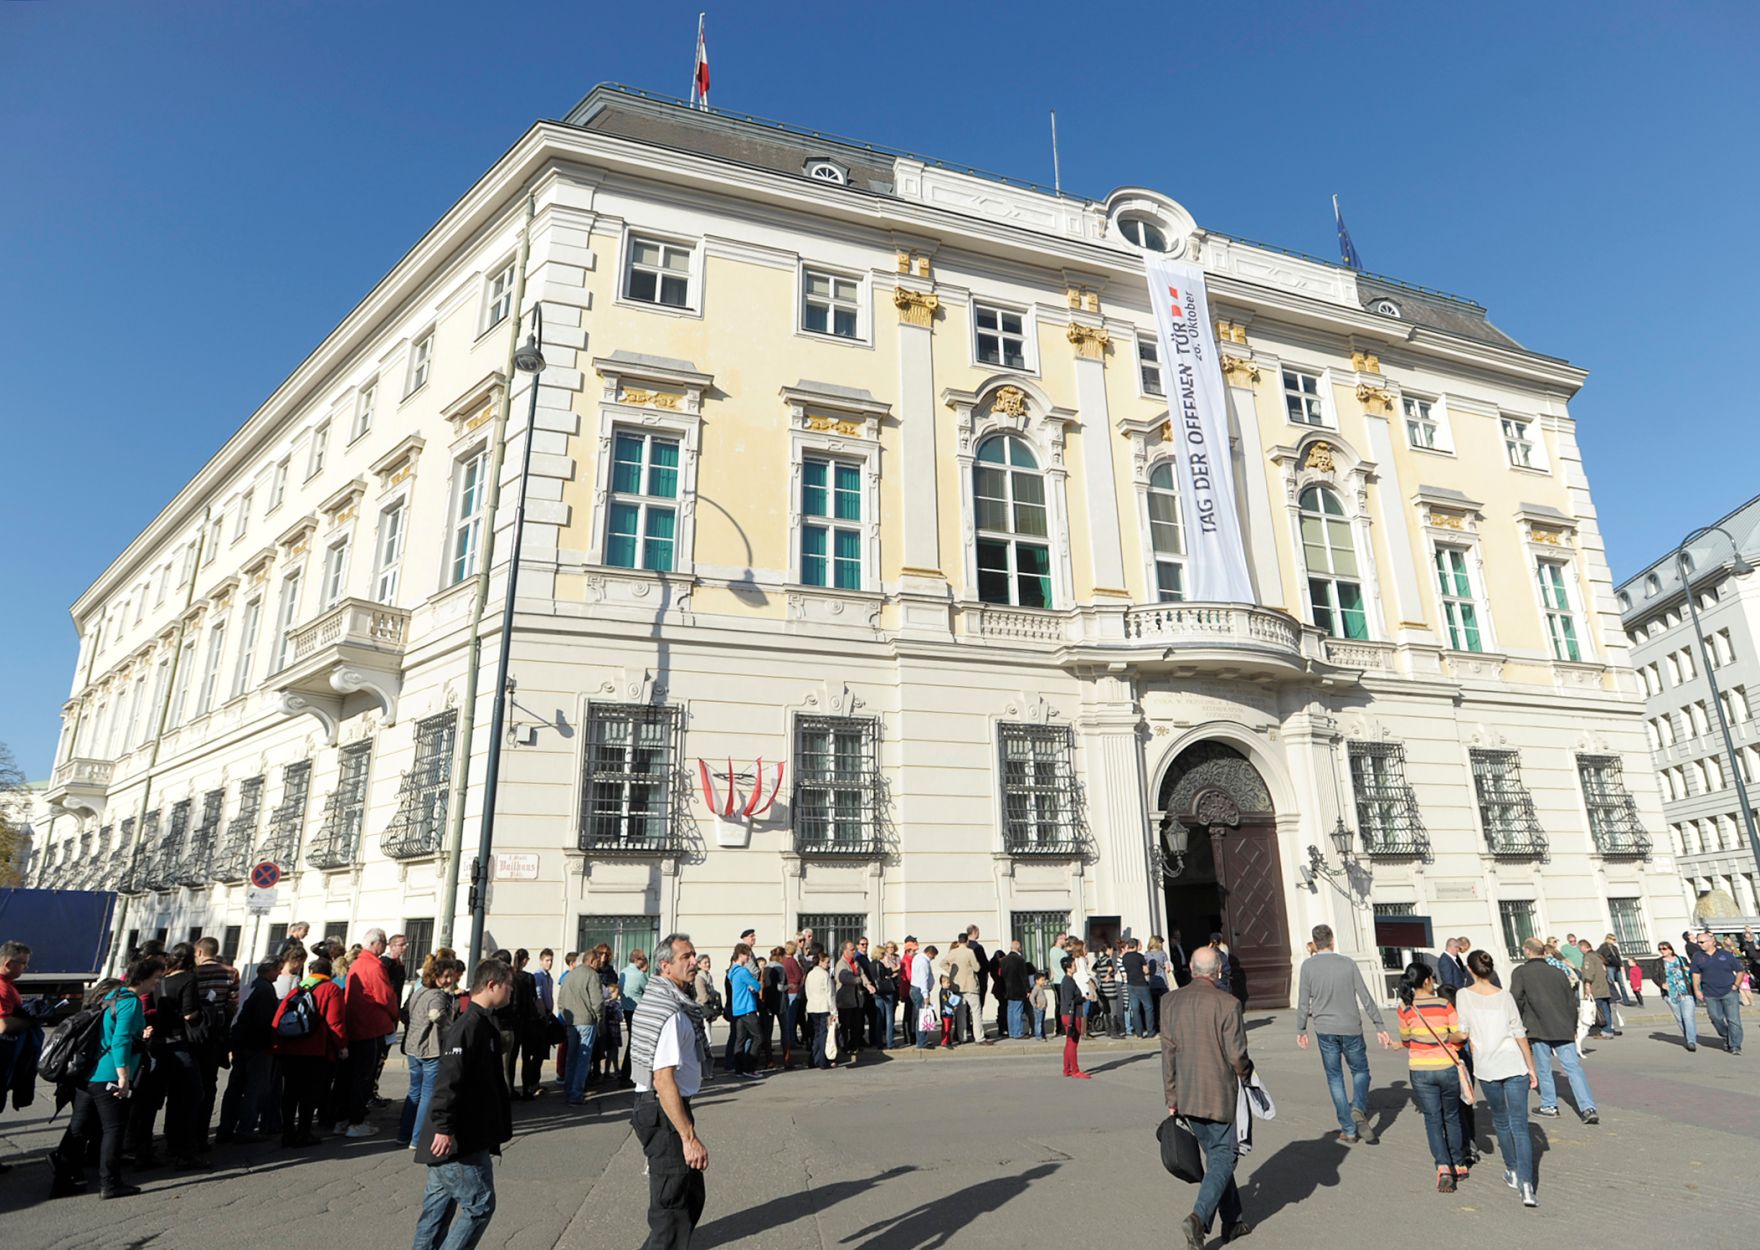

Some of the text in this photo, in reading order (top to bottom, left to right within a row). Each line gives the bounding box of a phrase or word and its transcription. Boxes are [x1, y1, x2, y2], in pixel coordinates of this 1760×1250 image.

[1184, 289, 1200, 338] Oktober
[1170, 322, 1217, 535] TAG DER OFFENEN TÜR
